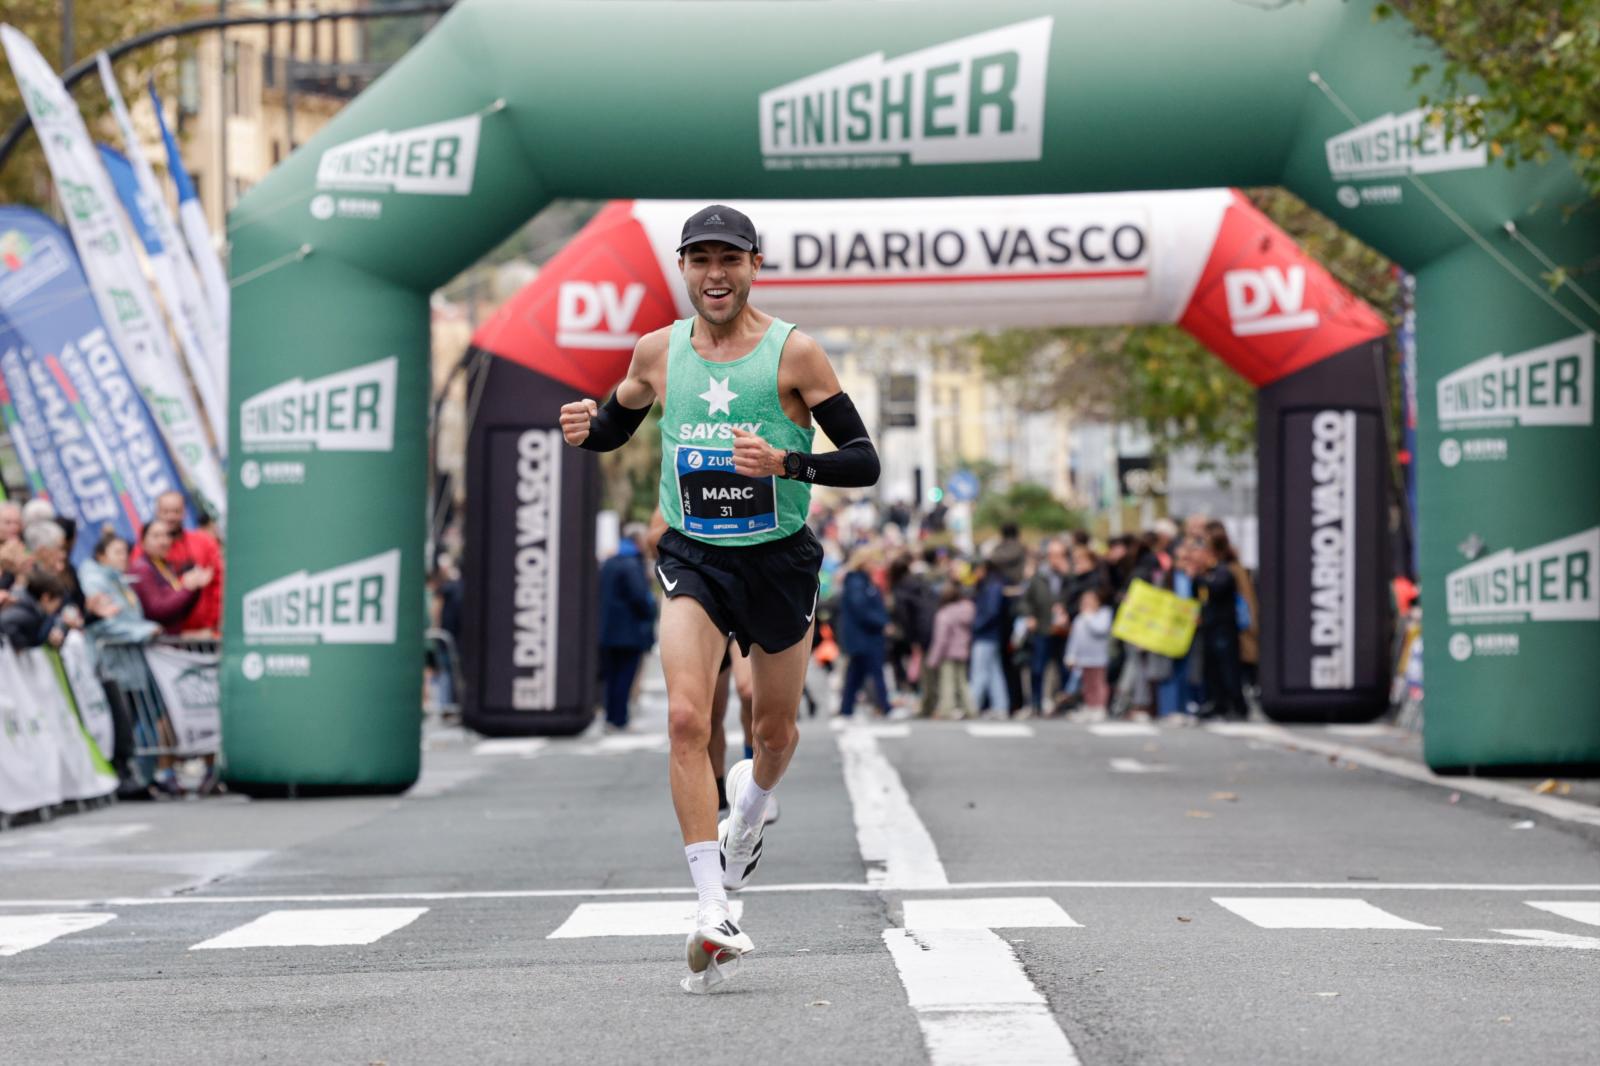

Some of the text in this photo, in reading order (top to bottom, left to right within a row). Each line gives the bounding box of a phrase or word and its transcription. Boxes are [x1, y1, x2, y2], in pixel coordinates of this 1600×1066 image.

[772, 50, 1020, 148] FINISHER
[758, 224, 1146, 270] L DIARIO VASCO
[558, 282, 645, 333] DV
[1224, 265, 1306, 318] DV
[246, 381, 381, 434] FINISHER
[1443, 354, 1583, 412] FINISHER
[708, 456, 734, 466] ZUR
[1312, 410, 1343, 524] VASCO
[516, 430, 550, 546] VASCO
[702, 487, 753, 500] MARC
[720, 506, 733, 516] 31
[251, 574, 385, 627] FINISHER
[1311, 526, 1343, 646] DIARIO
[1452, 550, 1591, 608] FINISHER
[514, 552, 549, 667] DIARIO
